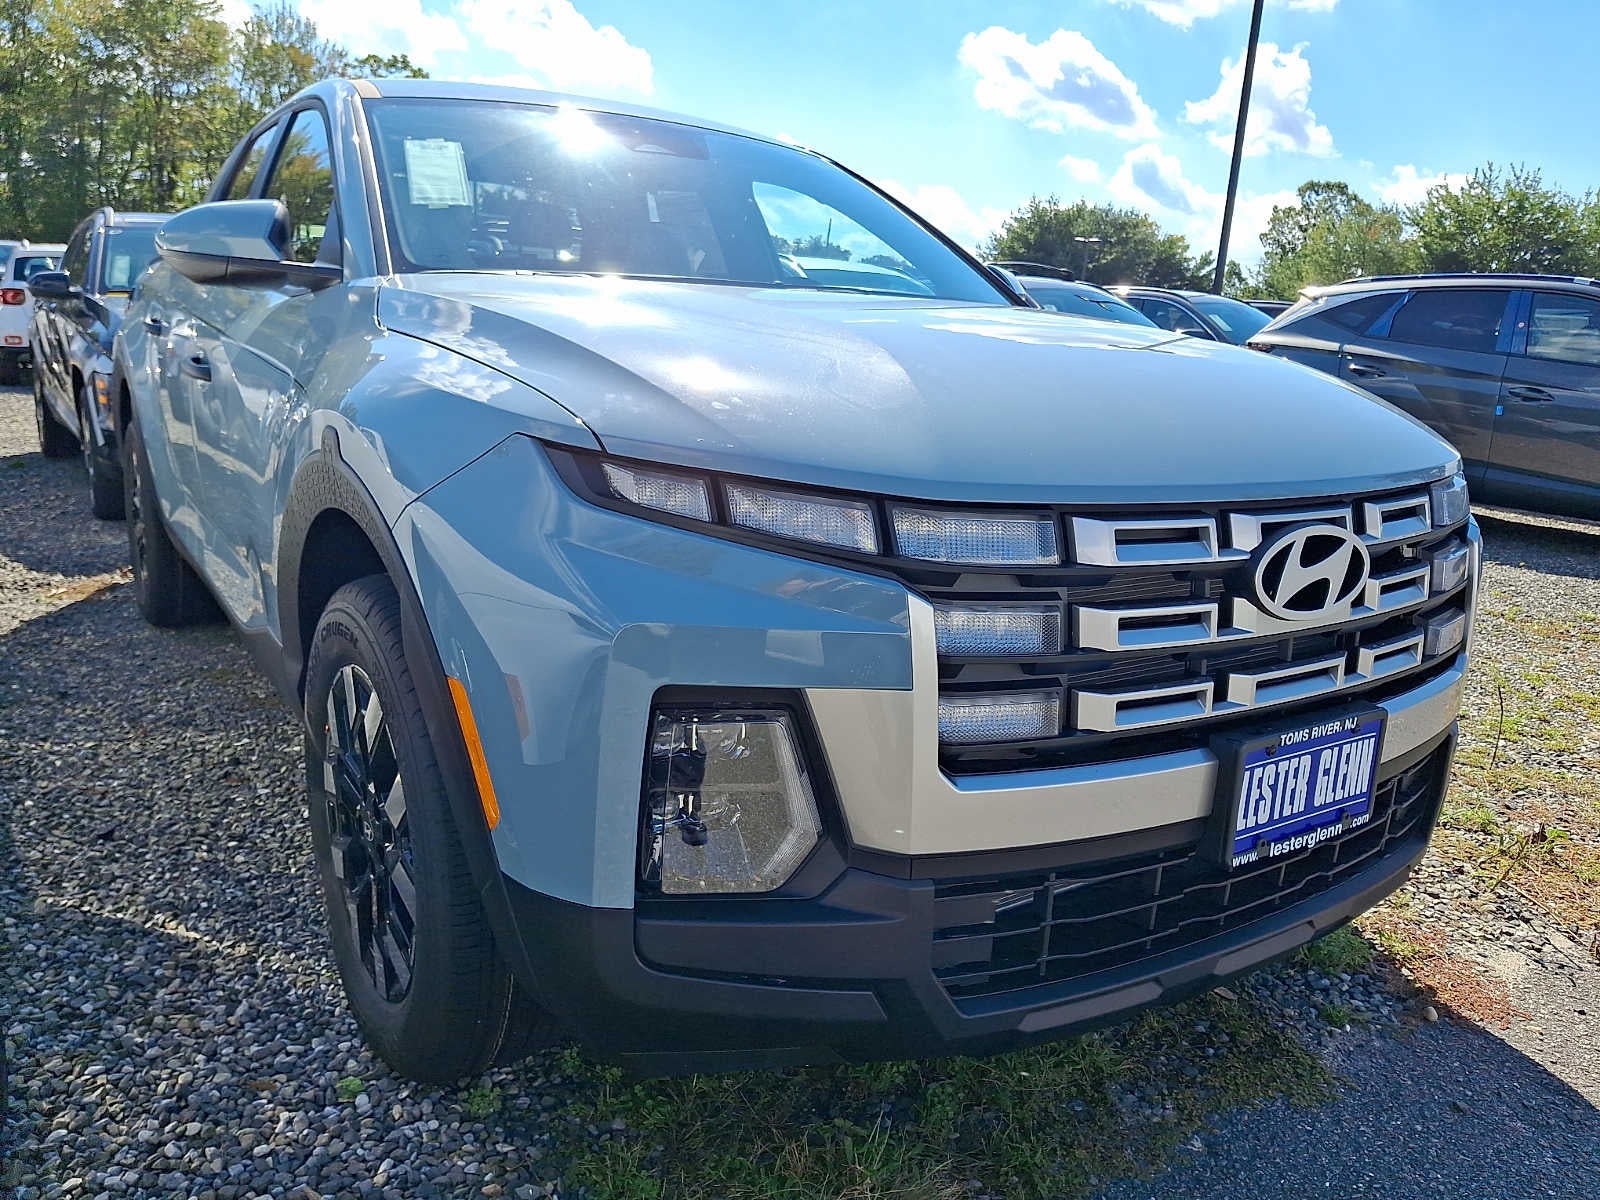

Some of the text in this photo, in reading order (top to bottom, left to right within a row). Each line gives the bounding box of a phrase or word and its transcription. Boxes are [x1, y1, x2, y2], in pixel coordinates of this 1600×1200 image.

[1280, 717, 1358, 746] TOMS RIVER, NJ
[1236, 738, 1376, 831] LESTER GLENN
